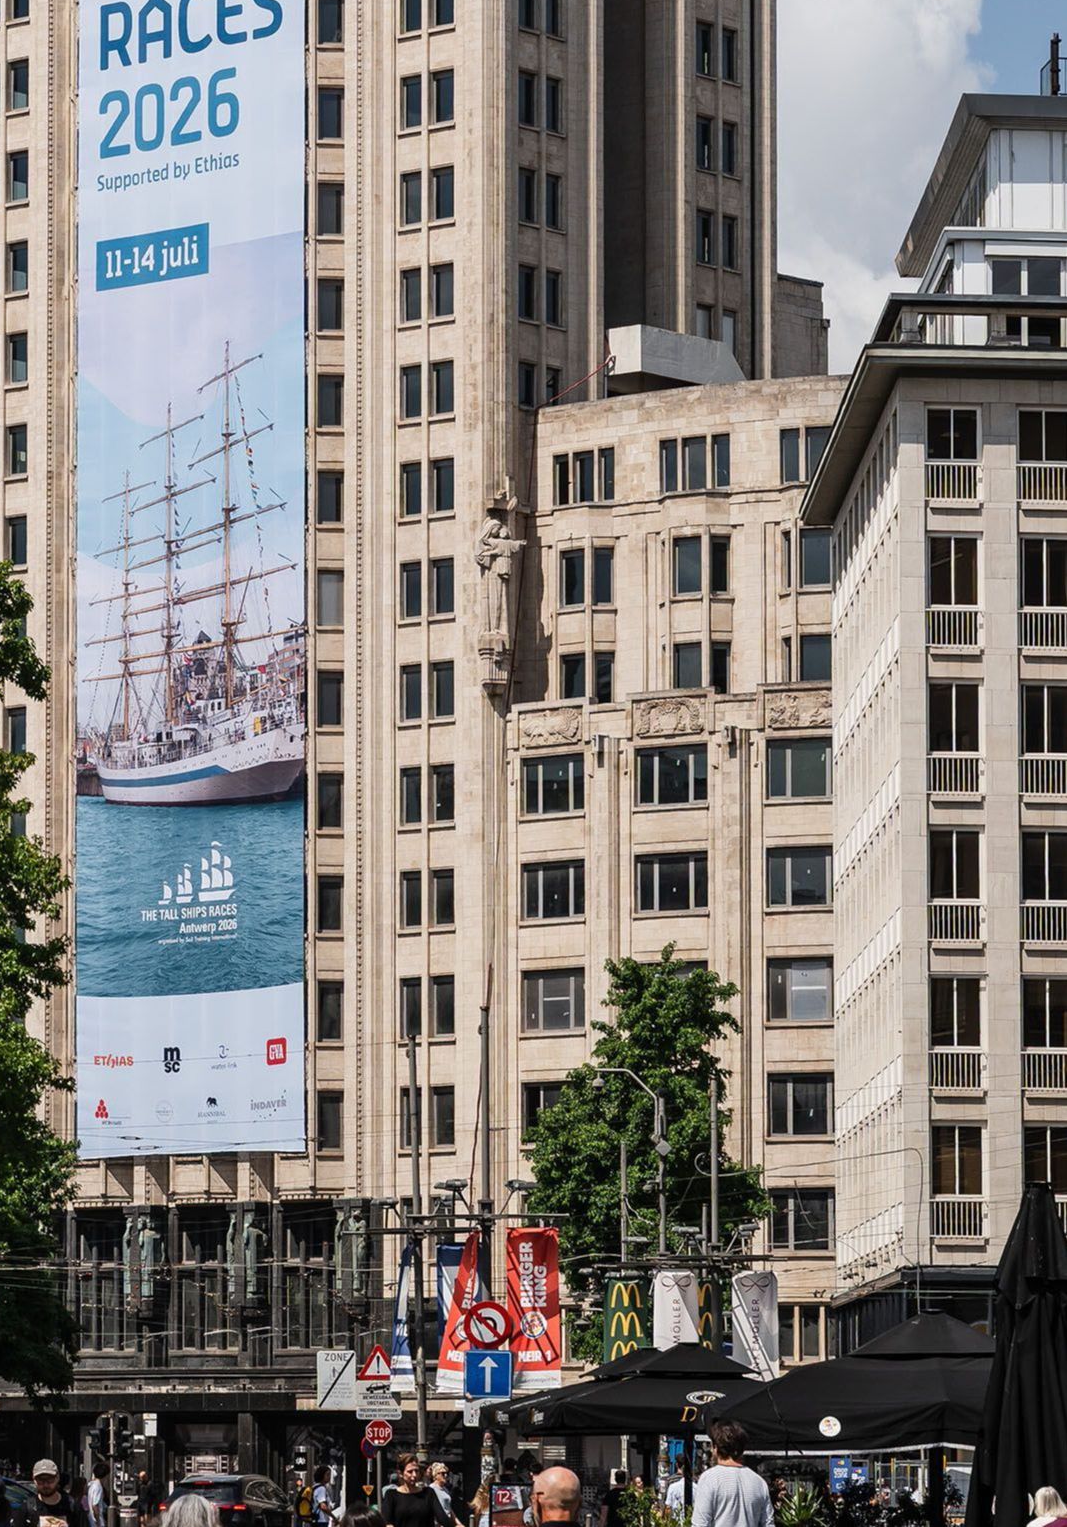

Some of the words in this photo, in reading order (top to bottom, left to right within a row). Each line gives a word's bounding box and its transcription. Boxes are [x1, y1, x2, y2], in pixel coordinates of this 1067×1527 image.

[98, 66, 240, 160] 2026
[96, 163, 170, 193] Supported
[173, 161, 191, 180] by
[195, 153, 240, 174] Ethias
[105, 244, 156, 279] 11-14
[159, 234, 200, 276] juli
[141, 909, 158, 922] THE
[159, 908, 180, 921] TALL
[181, 906, 207, 919] SHIPS
[209, 903, 238, 917] RACES
[179, 922, 217, 935] Antwerp
[218, 919, 238, 932] 2026
[519, 1241, 534, 1308] BURGER
[534, 1265, 548, 1308] KING
[324, 1353, 348, 1362] ZONE
[518, 1350, 541, 1363] MEIR
[366, 1427, 391, 1438] STOP
[497, 1490, 511, 1504] T2
